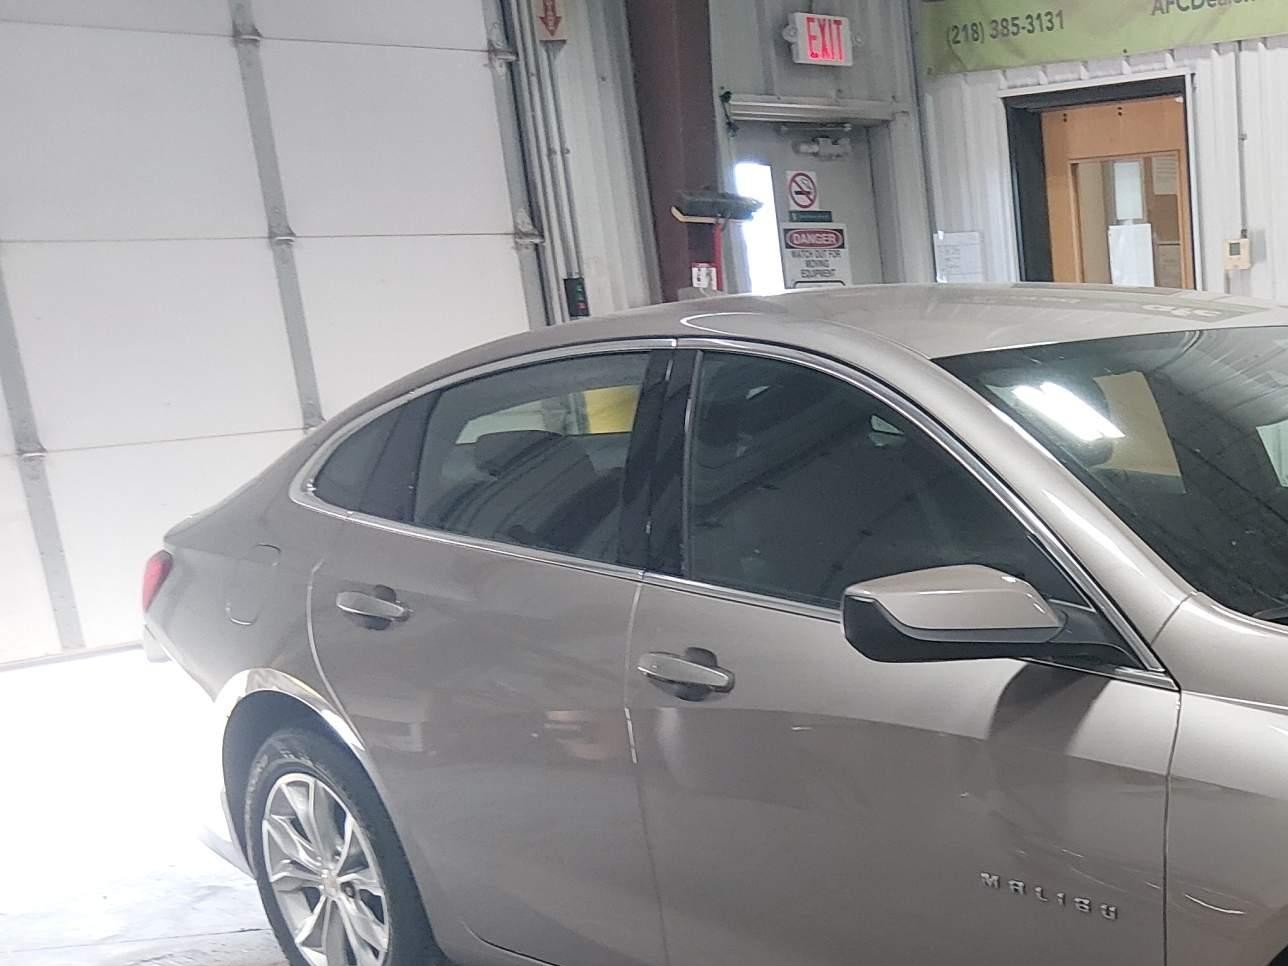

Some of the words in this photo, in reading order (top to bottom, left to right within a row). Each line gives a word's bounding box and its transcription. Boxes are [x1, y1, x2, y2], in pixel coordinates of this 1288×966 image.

[806, 16, 844, 61] EXIT
[946, 21, 985, 48] (218)
[990, 9, 1064, 39] 385-3131
[791, 232, 837, 245] DANGER
[980, 872, 1118, 921] MALIBU
